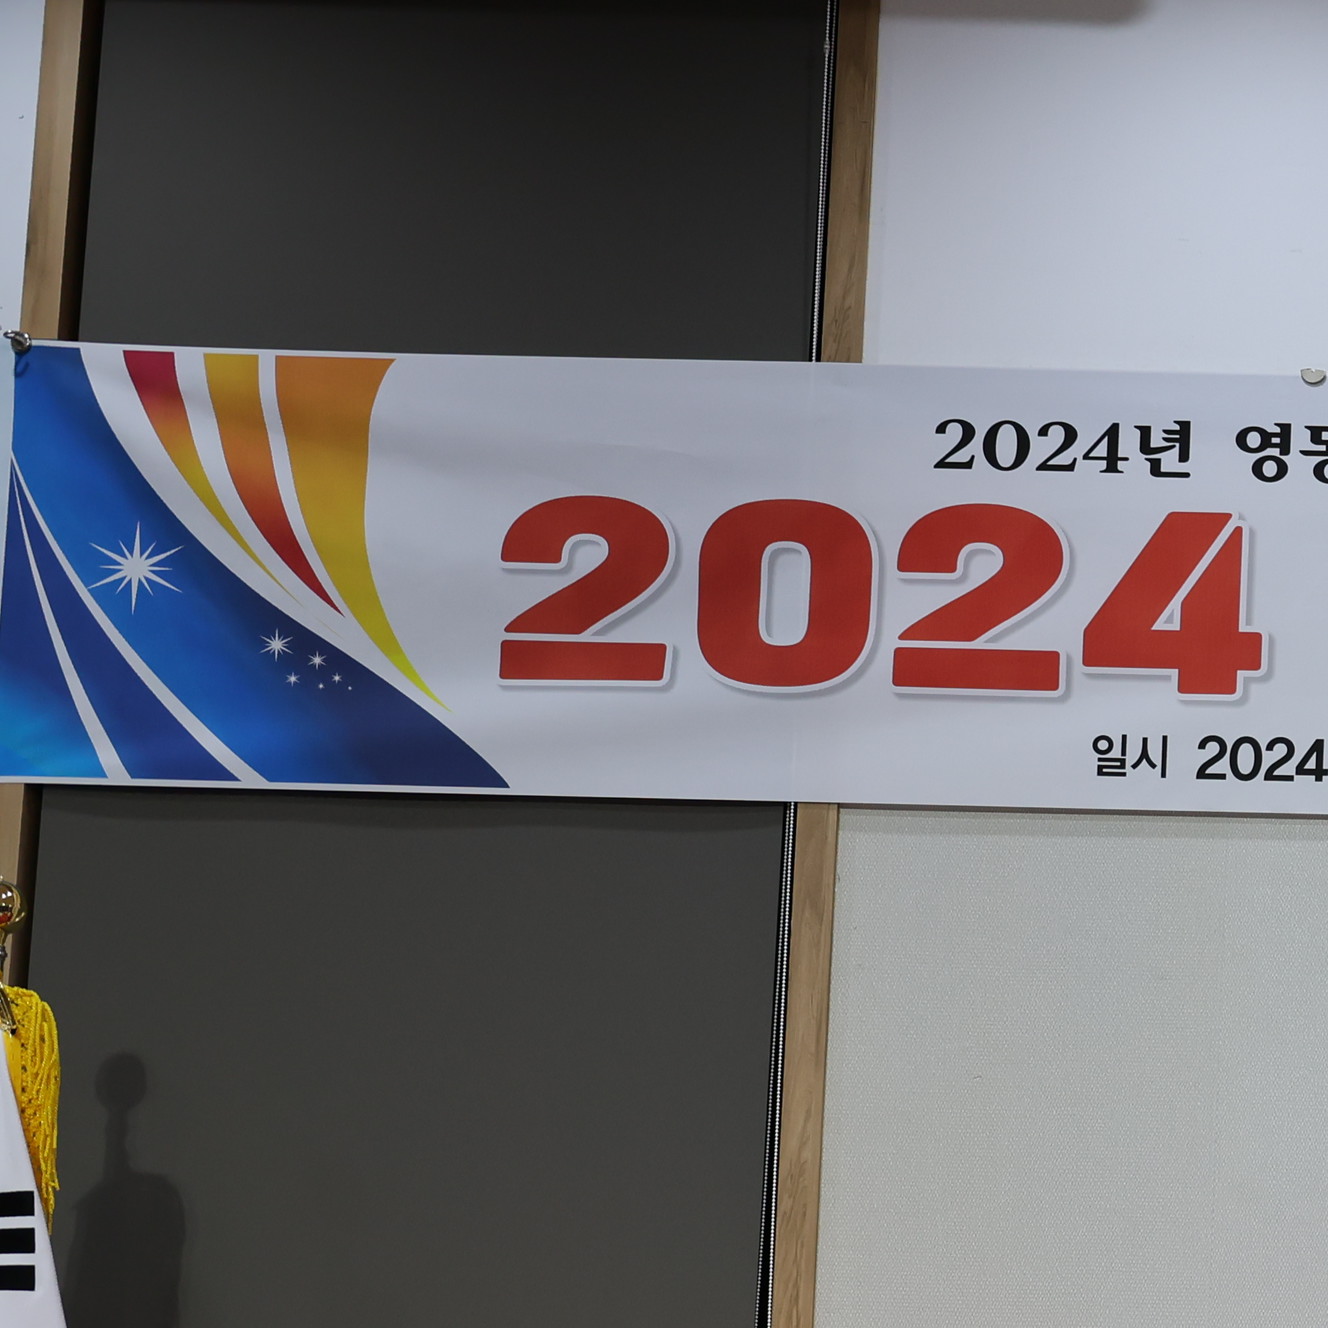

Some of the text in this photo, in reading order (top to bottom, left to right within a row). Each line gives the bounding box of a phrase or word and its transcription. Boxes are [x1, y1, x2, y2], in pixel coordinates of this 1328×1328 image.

[933, 418, 1191, 479] 2024년
[501, 495, 1262, 695] 2024
[1092, 734, 1168, 779] 일시
